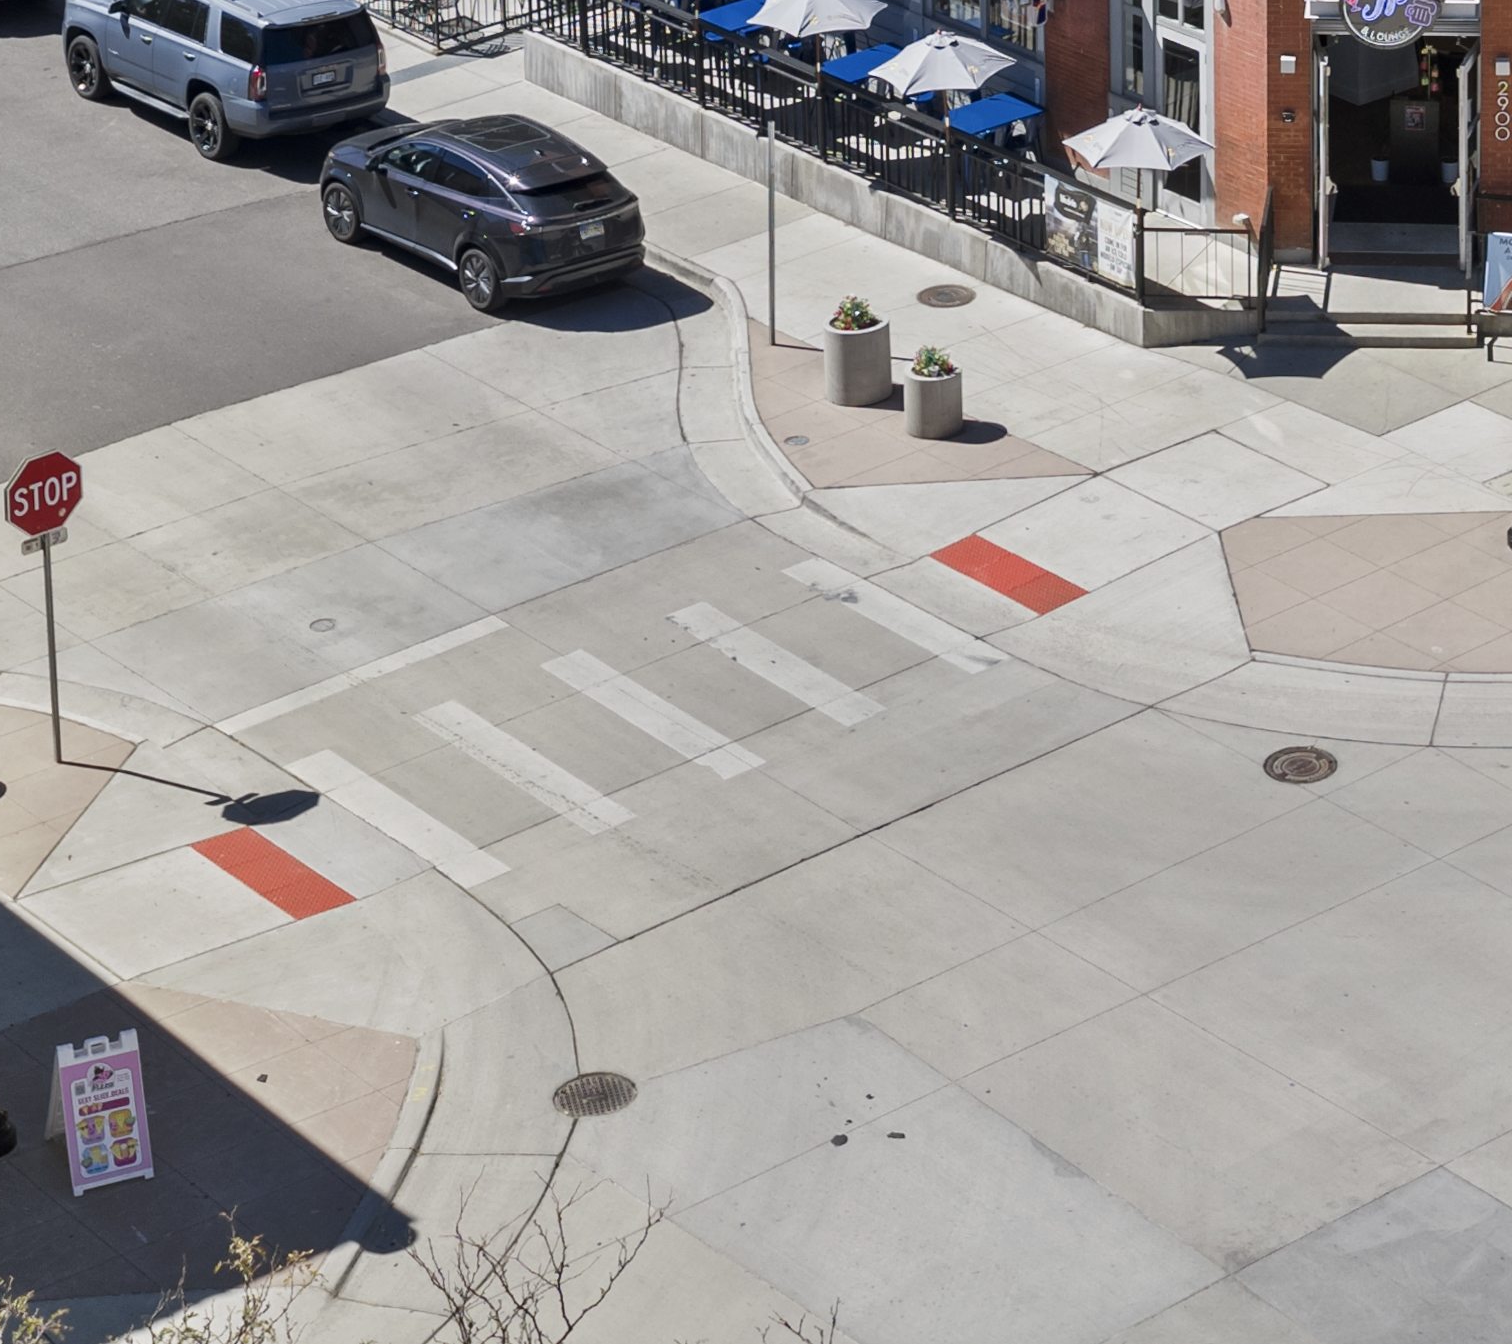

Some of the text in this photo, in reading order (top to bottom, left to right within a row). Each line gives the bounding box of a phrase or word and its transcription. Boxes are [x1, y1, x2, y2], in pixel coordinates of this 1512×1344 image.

[1370, 26, 1412, 42] LOUNGE
[1495, 81, 1510, 141] 2900
[13, 471, 77, 517] STOP
